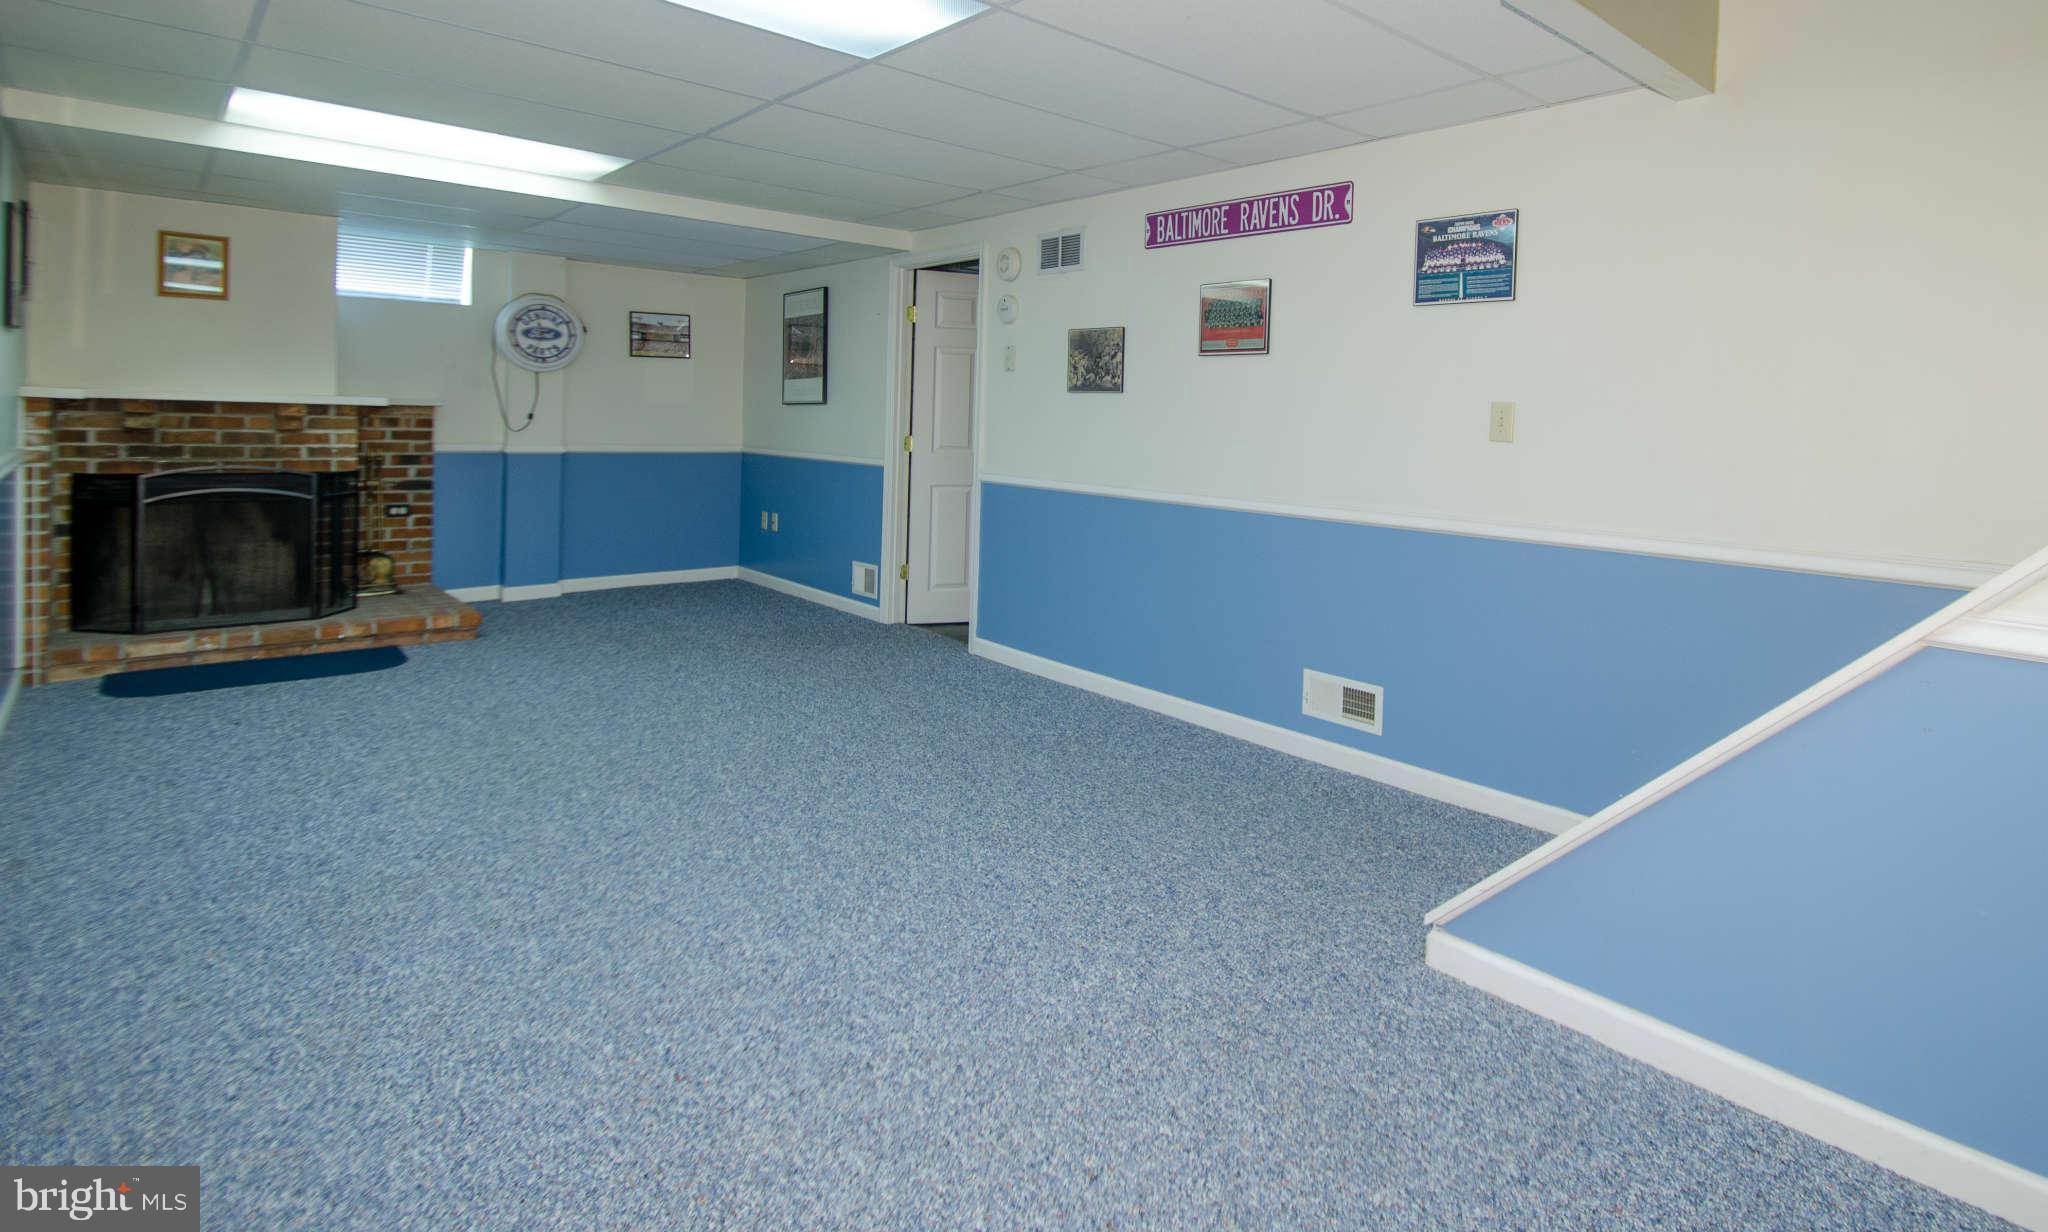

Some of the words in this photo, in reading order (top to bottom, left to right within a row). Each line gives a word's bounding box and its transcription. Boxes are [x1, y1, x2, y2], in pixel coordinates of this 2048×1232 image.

[1157, 206, 1229, 242] BALTIMORE
[1240, 195, 1300, 232] RAVENS
[1312, 190, 1340, 222] DR.
[1433, 232, 1471, 243] BALTIMORE
[1472, 229, 1499, 239] RAVENS
